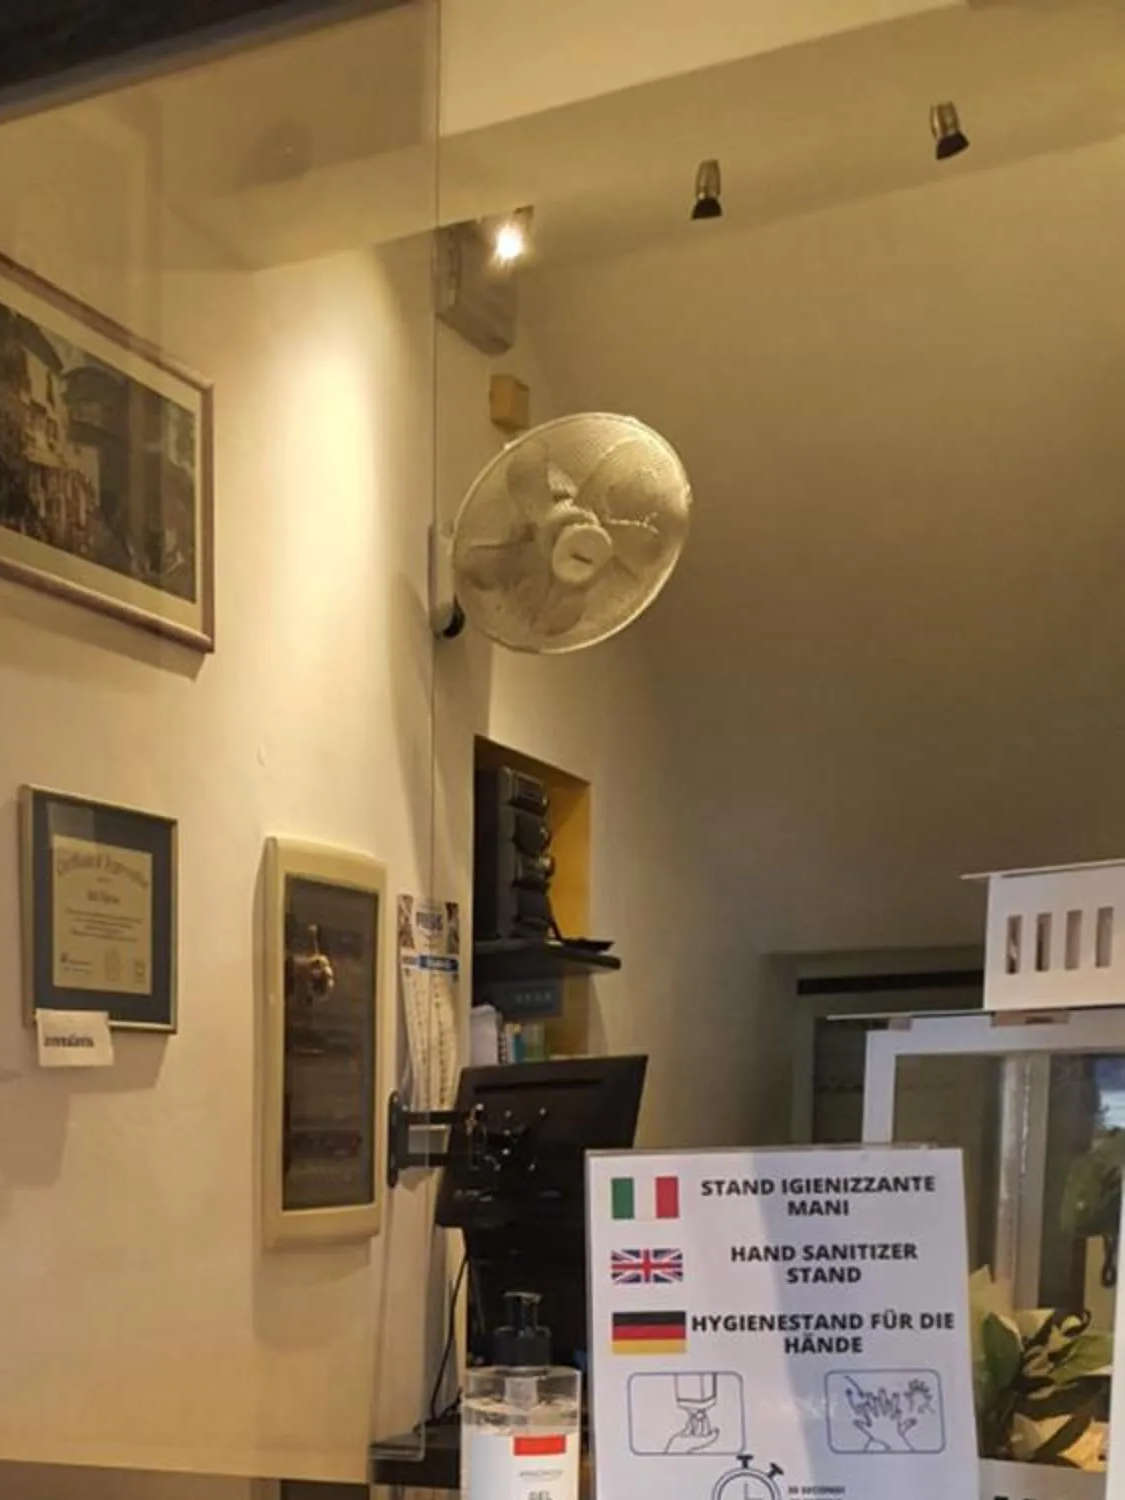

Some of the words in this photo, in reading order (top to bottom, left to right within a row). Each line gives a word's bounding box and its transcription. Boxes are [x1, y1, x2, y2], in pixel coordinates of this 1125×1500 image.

[700, 1178, 775, 1197] STAND
[780, 1175, 936, 1195] IGIENIZZANTE
[786, 1199, 850, 1217] MANI
[730, 1244, 796, 1263] HAND
[801, 1242, 918, 1261] SANITIZER
[786, 1265, 862, 1284] STAND
[690, 1312, 865, 1333] HYGIENESTAND
[870, 1308, 915, 1331] FÜR
[920, 1311, 955, 1330] DIE
[783, 1333, 864, 1355] HÄNDE
